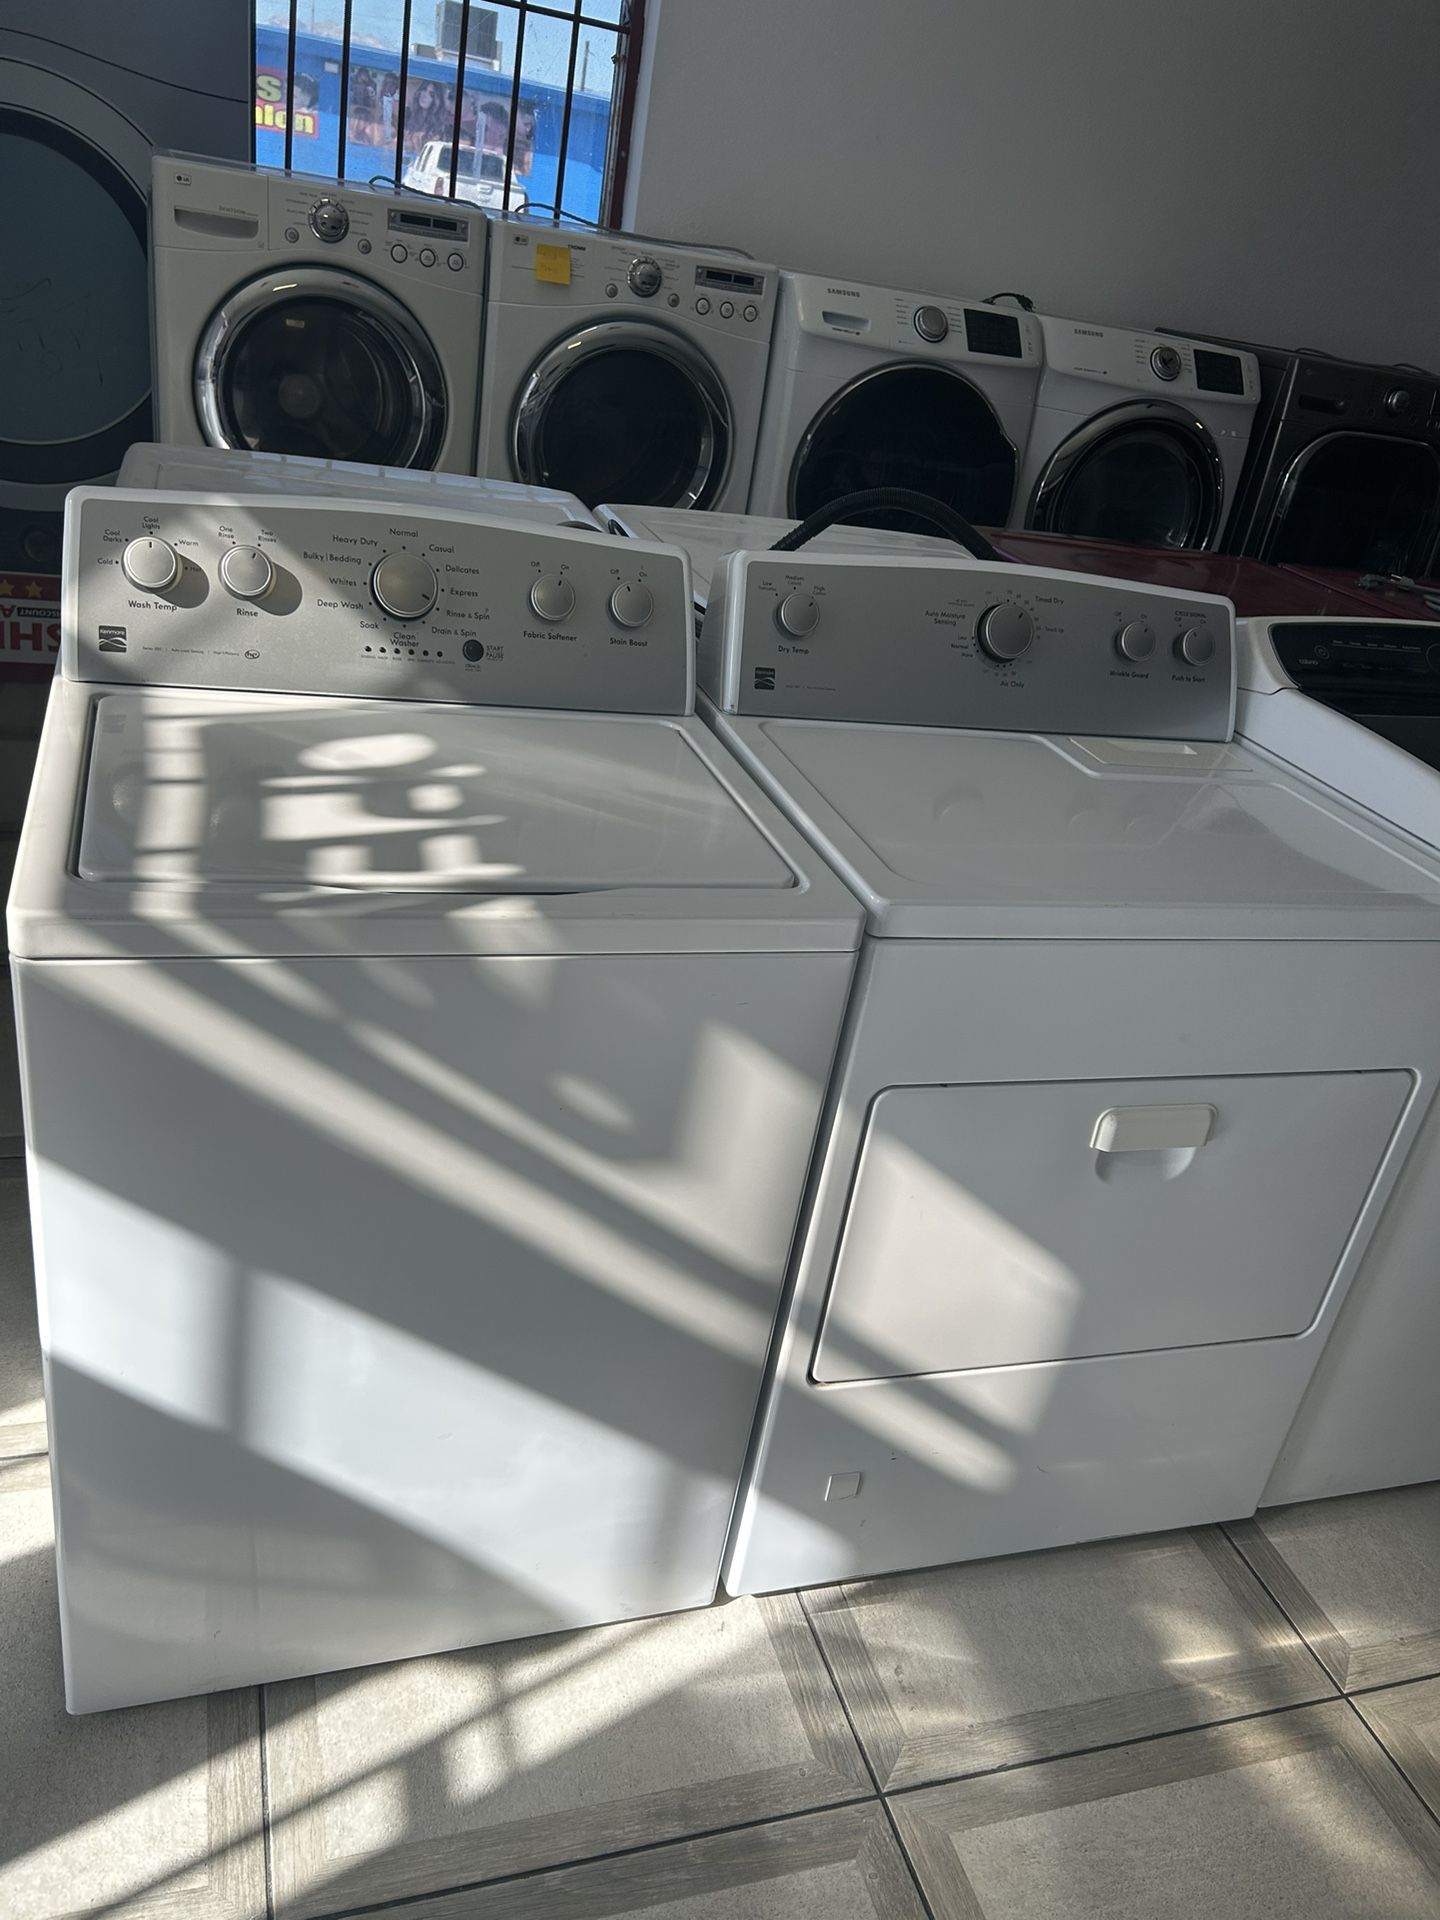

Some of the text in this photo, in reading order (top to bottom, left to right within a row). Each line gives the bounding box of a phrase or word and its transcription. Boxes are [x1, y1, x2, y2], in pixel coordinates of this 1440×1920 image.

[827, 288, 860, 298] SAMSUNG
[1074, 328, 1104, 338] SAMSUNG
[219, 525, 233, 533] One
[389, 528, 419, 538] Normal
[178, 539, 199, 547] Warm
[332, 534, 378, 547] Heavy Duty
[428, 544, 455, 553] Casual
[97, 557, 113, 565] Cold
[445, 564, 480, 575] Delicates
[328, 577, 357, 587] Whites
[450, 587, 478, 598] Express
[128, 599, 178, 612] Wash Temp
[317, 598, 364, 610] Deep Wash
[1053, 597, 1064, 605] Dry
[236, 608, 258, 617] Rinse
[446, 609, 465, 618] Rinse
[474, 611, 490, 621] Spin
[359, 620, 379, 629] Soak
[393, 631, 416, 640] Clean
[431, 626, 452, 636] Drain
[460, 628, 477, 638] Spin
[523, 630, 578, 642] Fabric Softener
[389, 638, 419, 648] Washer
[609, 637, 648, 647] Stain Boost
[778, 645, 810, 655] Dry Temp
